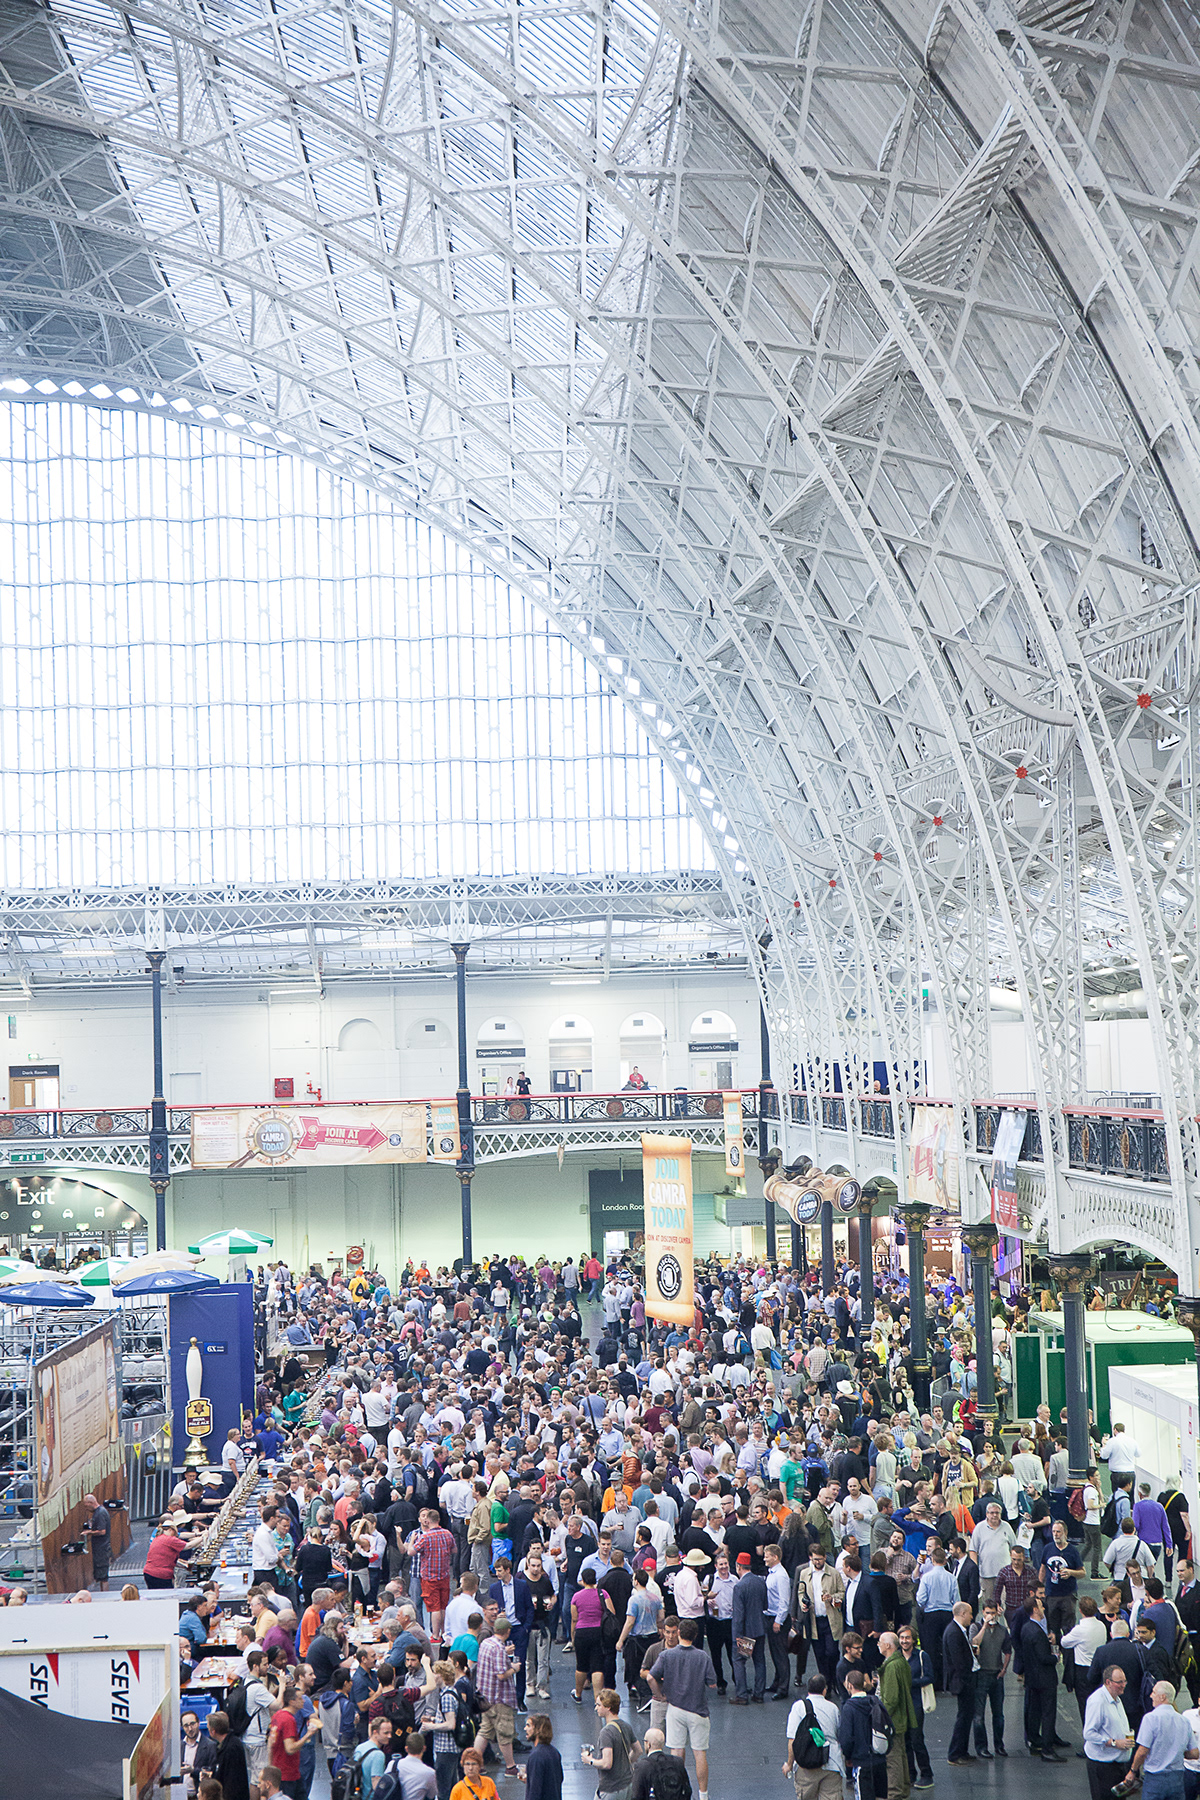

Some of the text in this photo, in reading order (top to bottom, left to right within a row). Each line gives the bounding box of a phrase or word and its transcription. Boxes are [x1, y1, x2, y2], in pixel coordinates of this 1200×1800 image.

[435, 1115, 456, 1123] CAMRA
[265, 1124, 281, 1132] JOIN
[436, 1122, 455, 1130] TODAY
[261, 1133, 285, 1142] CAMRA
[325, 1128, 360, 1139] JOIN AT
[262, 1143, 284, 1151] TODAY
[655, 1158, 679, 1180] JOIN
[17, 1186, 55, 1205] Exit
[650, 1182, 687, 1206] CAMRA
[799, 1200, 818, 1211] CAMRA
[651, 1206, 686, 1230] TODAY
[799, 1209, 817, 1219] TODAY
[661, 1235, 678, 1244] DISCOVER
[658, 1257, 680, 1273] DISCOVER
[155, 1278, 176, 1286] 6X
